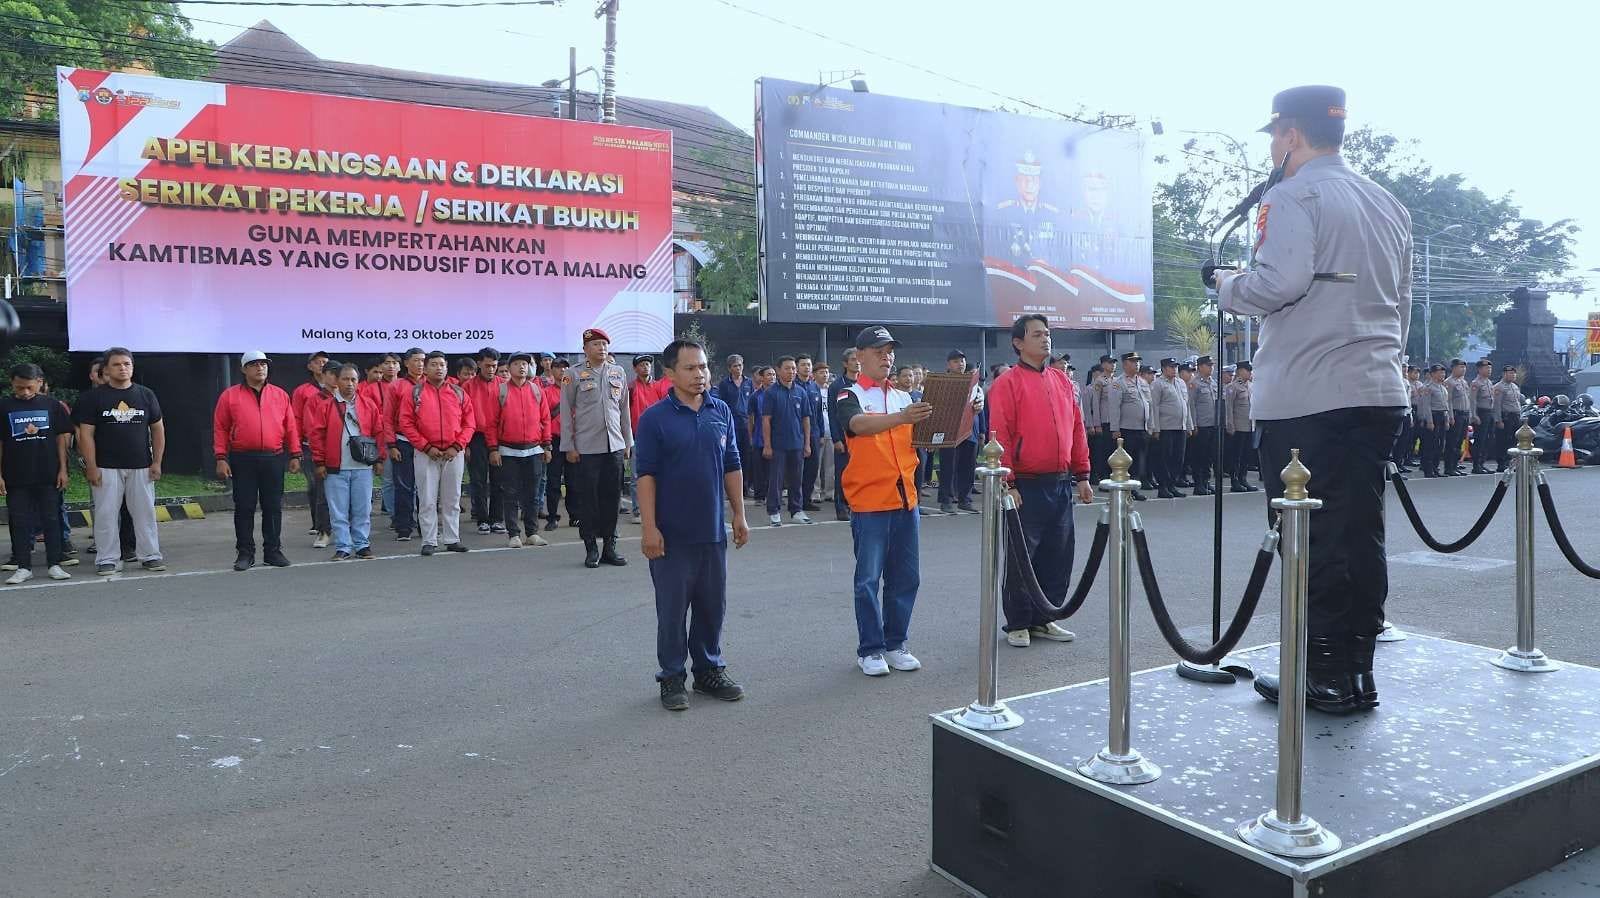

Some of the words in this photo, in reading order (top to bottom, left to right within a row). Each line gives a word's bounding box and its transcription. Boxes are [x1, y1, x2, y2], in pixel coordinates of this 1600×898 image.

[789, 128, 830, 142] COMMANDER
[831, 134, 847, 143] WISH
[140, 136, 223, 165] APEL
[230, 143, 447, 181] KEBANGSAAN
[453, 161, 474, 183] &
[481, 163, 624, 194] DEKLARASI
[118, 176, 262, 209] SERIKAT
[269, 187, 405, 217] PEKERJA
[553, 205, 640, 231] BURUH
[248, 224, 321, 245] GUNA
[327, 228, 545, 255] MEMPERTAHANKAN
[109, 242, 272, 266] KAMTIBMAS
[278, 249, 349, 269] YANG
[355, 252, 469, 273] KONDUSIF
[475, 257, 496, 275] DI
[501, 259, 558, 277] KOTA
[563, 261, 647, 280] MALANG
[821, 303, 841, 311] TERKAIT
[301, 328, 354, 342] Malang
[357, 328, 391, 341] Kota,
[394, 329, 408, 340] 23
[411, 328, 462, 340] Oktober
[465, 329, 494, 340] 2025
[14, 416, 47, 424] RANVEER
[102, 409, 144, 417] RANVEER
